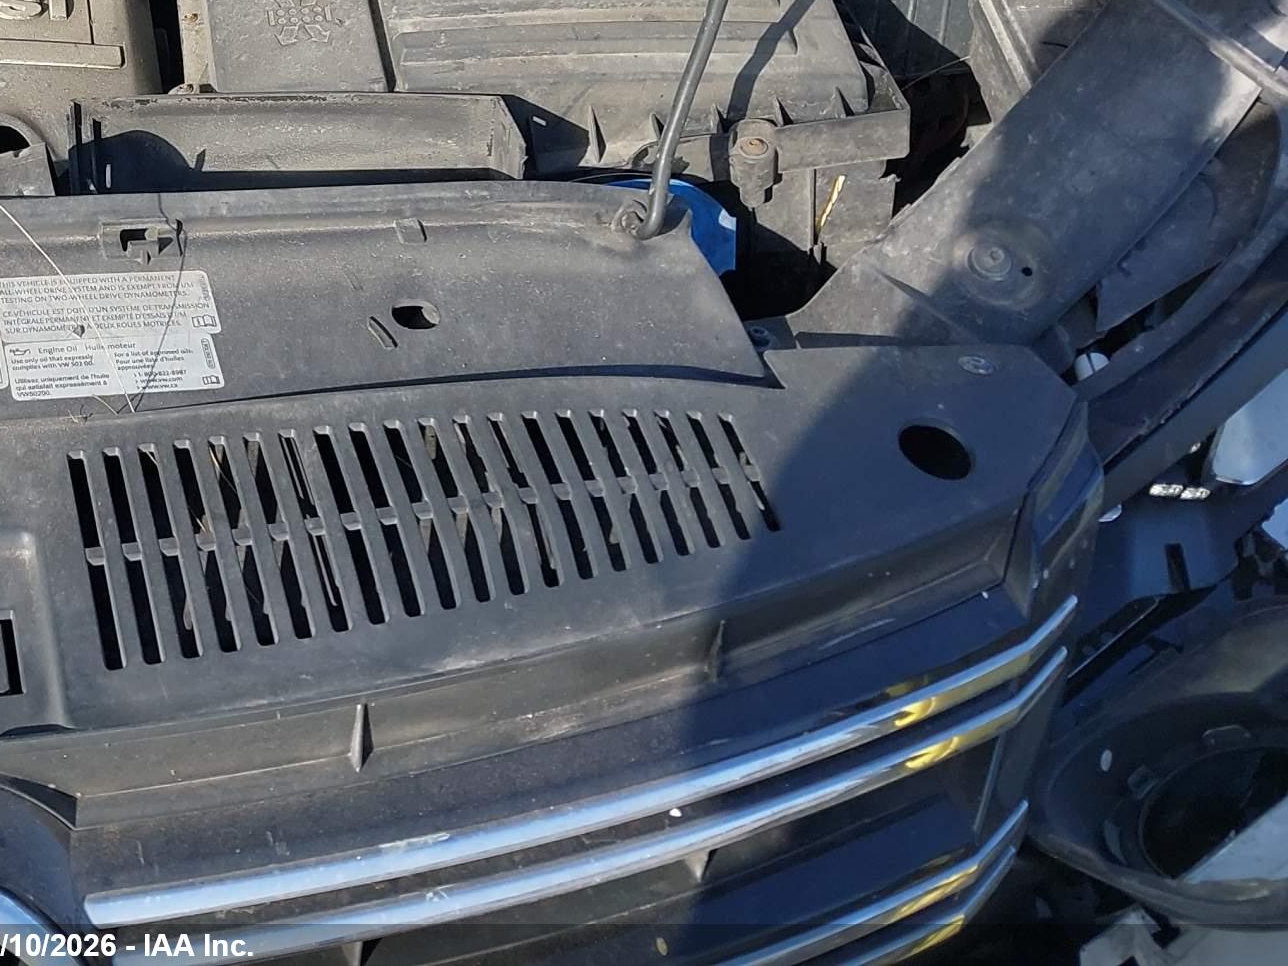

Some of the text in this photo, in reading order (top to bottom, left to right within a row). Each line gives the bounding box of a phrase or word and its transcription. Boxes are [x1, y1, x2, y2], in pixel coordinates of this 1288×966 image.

[0, 296, 33, 304] TESTING
[38, 346, 66, 355] Engine
[107, 342, 136, 350] moteur
